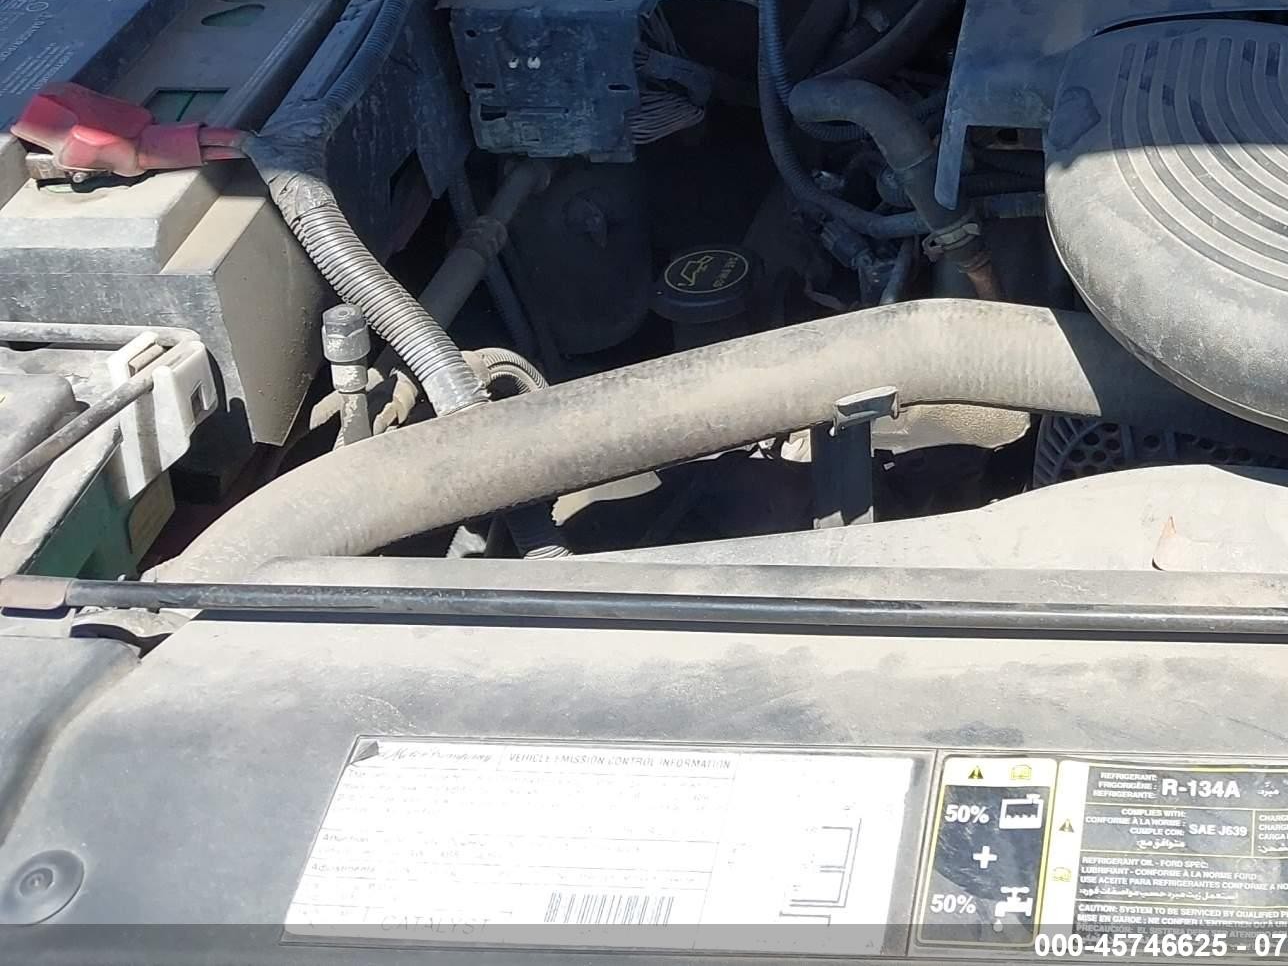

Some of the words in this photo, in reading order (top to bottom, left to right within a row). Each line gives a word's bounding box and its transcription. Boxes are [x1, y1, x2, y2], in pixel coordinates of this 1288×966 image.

[509, 753, 550, 763] VEHICLE
[554, 755, 604, 765] EMISSION
[608, 756, 655, 767] CONTROL
[660, 759, 732, 769] INFORMATION
[1160, 779, 1241, 799] R-134A
[945, 804, 990, 823] 50%
[1121, 808, 1162, 816] COMPLIES
[1086, 816, 1130, 824] CONFORME
[1189, 824, 1216, 835] SAE
[1218, 825, 1248, 836] J639
[1082, 857, 1139, 866] REFRIGERANT
[1161, 859, 1183, 867] FORD
[1135, 868, 1182, 876] CONFORME
[1191, 870, 1201, 878] LA
[1203, 871, 1232, 880] NORME
[1080, 876, 1097, 884] USE
[1099, 876, 1128, 885] ACEITE
[1129, 878, 1151, 886] PARA
[930, 894, 976, 914] 50%
[1079, 904, 1118, 912] CAUTION:
[1119, 906, 1153, 914] SYSTEM
[1180, 908, 1221, 917] SERVICED
[1223, 909, 1234, 917] BY
[1236, 910, 1279, 918] QUALIFIED
[1077, 914, 1097, 922] MISE
[1148, 916, 1159, 924] NE
